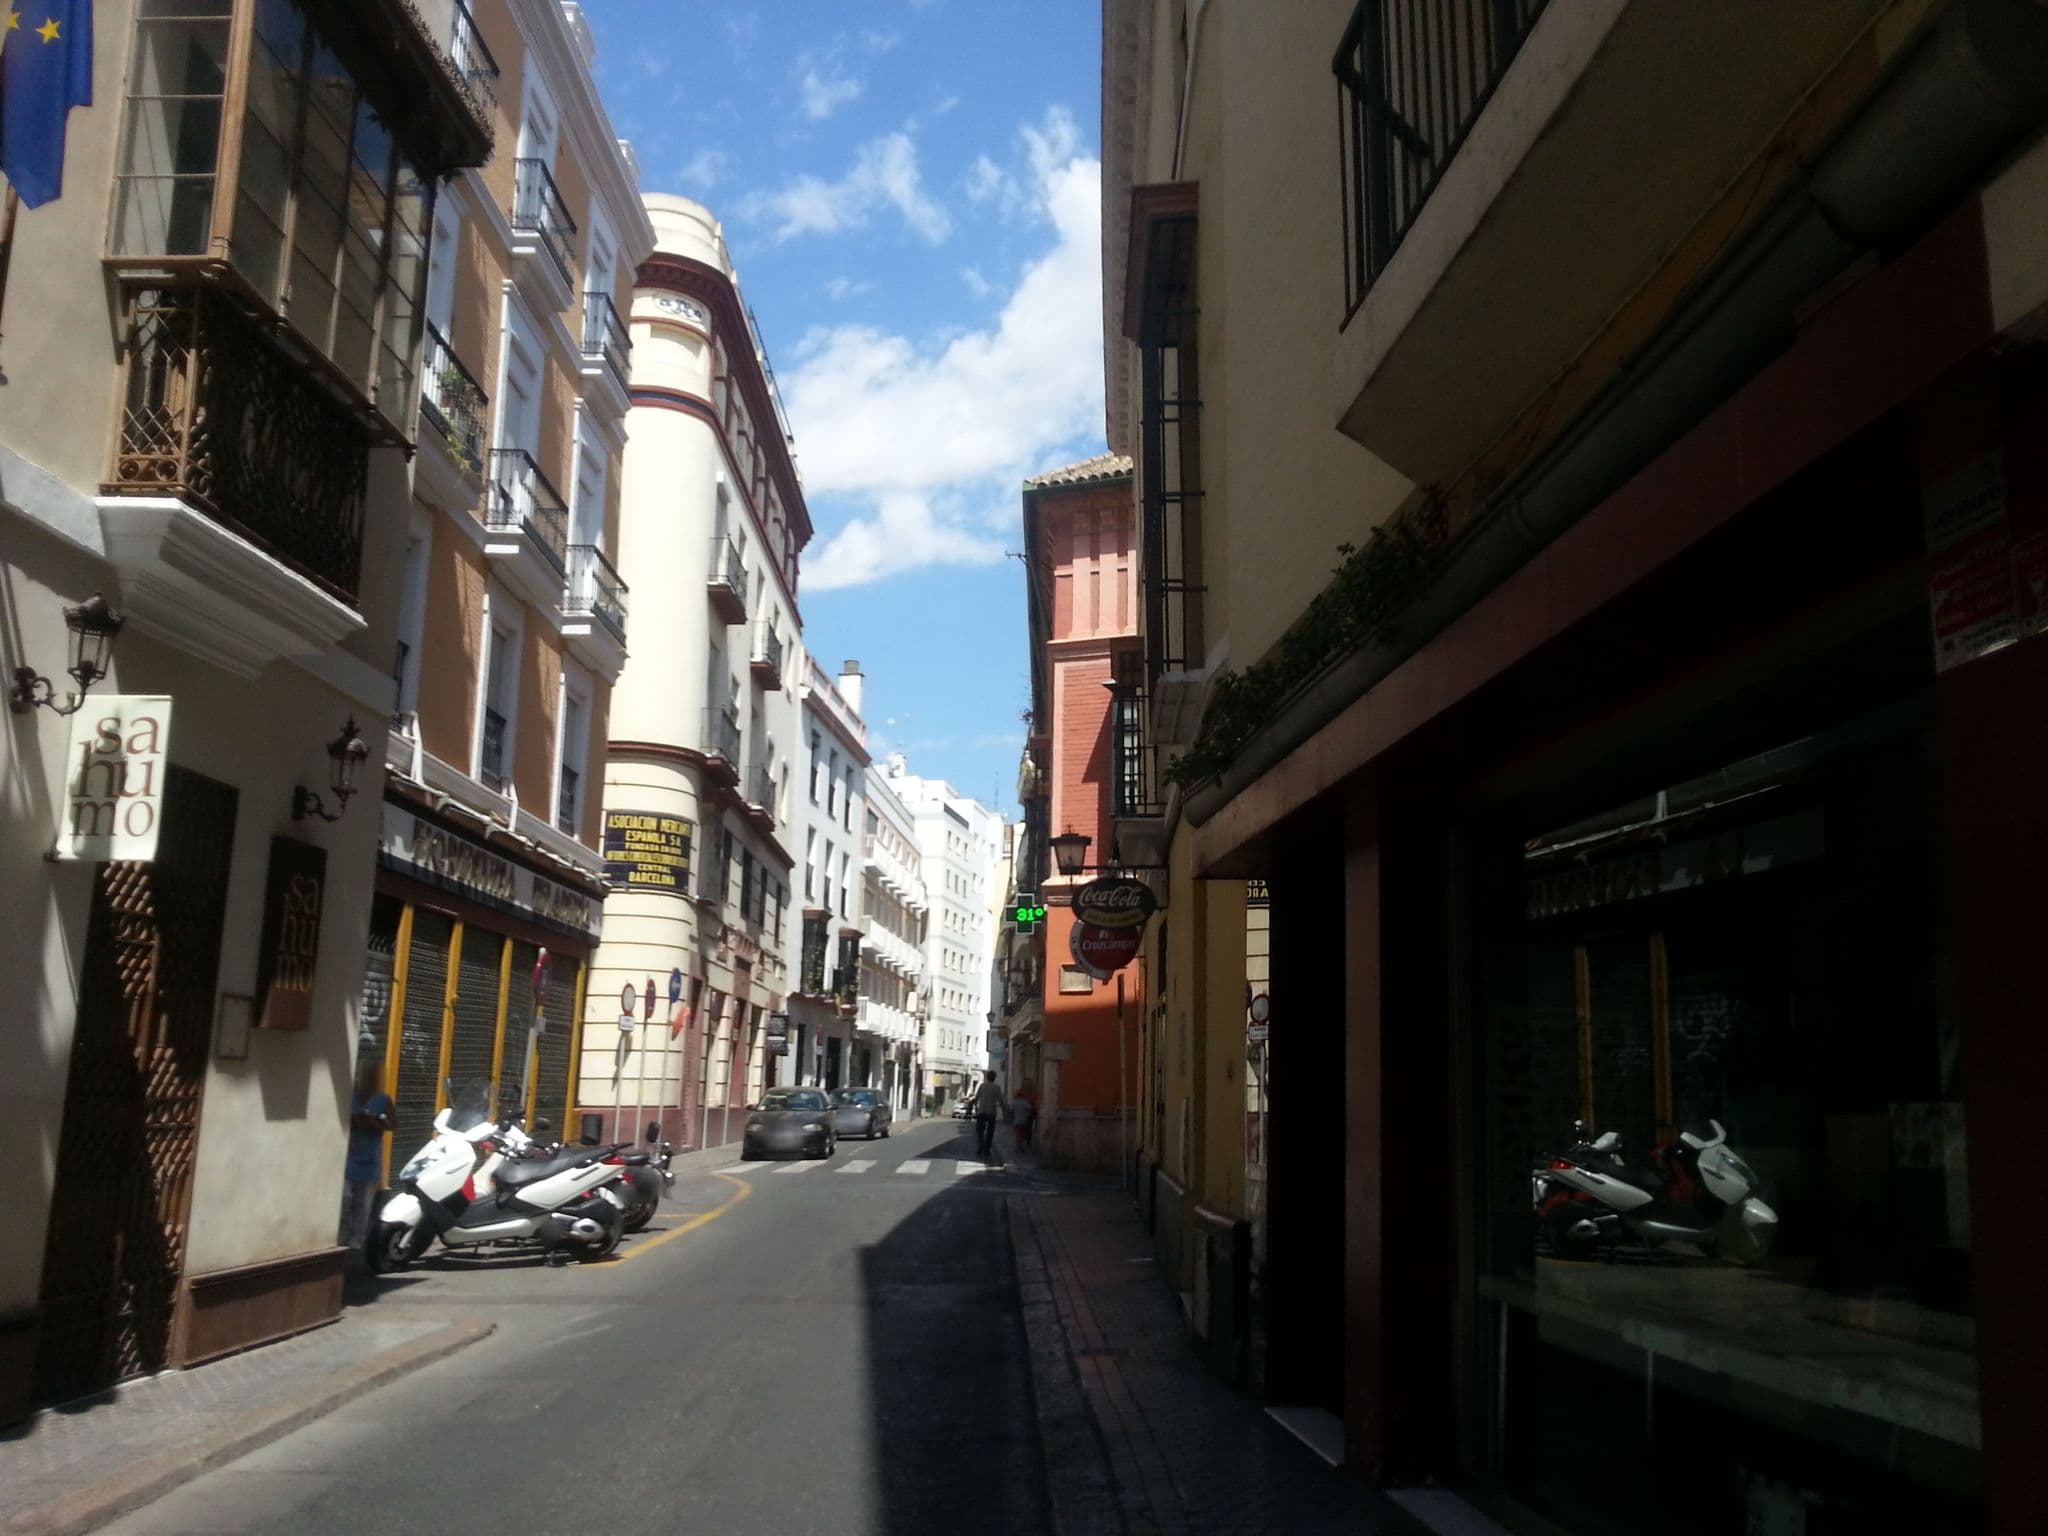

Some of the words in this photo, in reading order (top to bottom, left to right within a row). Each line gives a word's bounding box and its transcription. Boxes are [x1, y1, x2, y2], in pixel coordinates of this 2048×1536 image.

[94, 716, 160, 754] sa
[72, 739, 156, 797] hu
[69, 800, 154, 836] mo
[628, 872, 675, 885] BARCELONA
